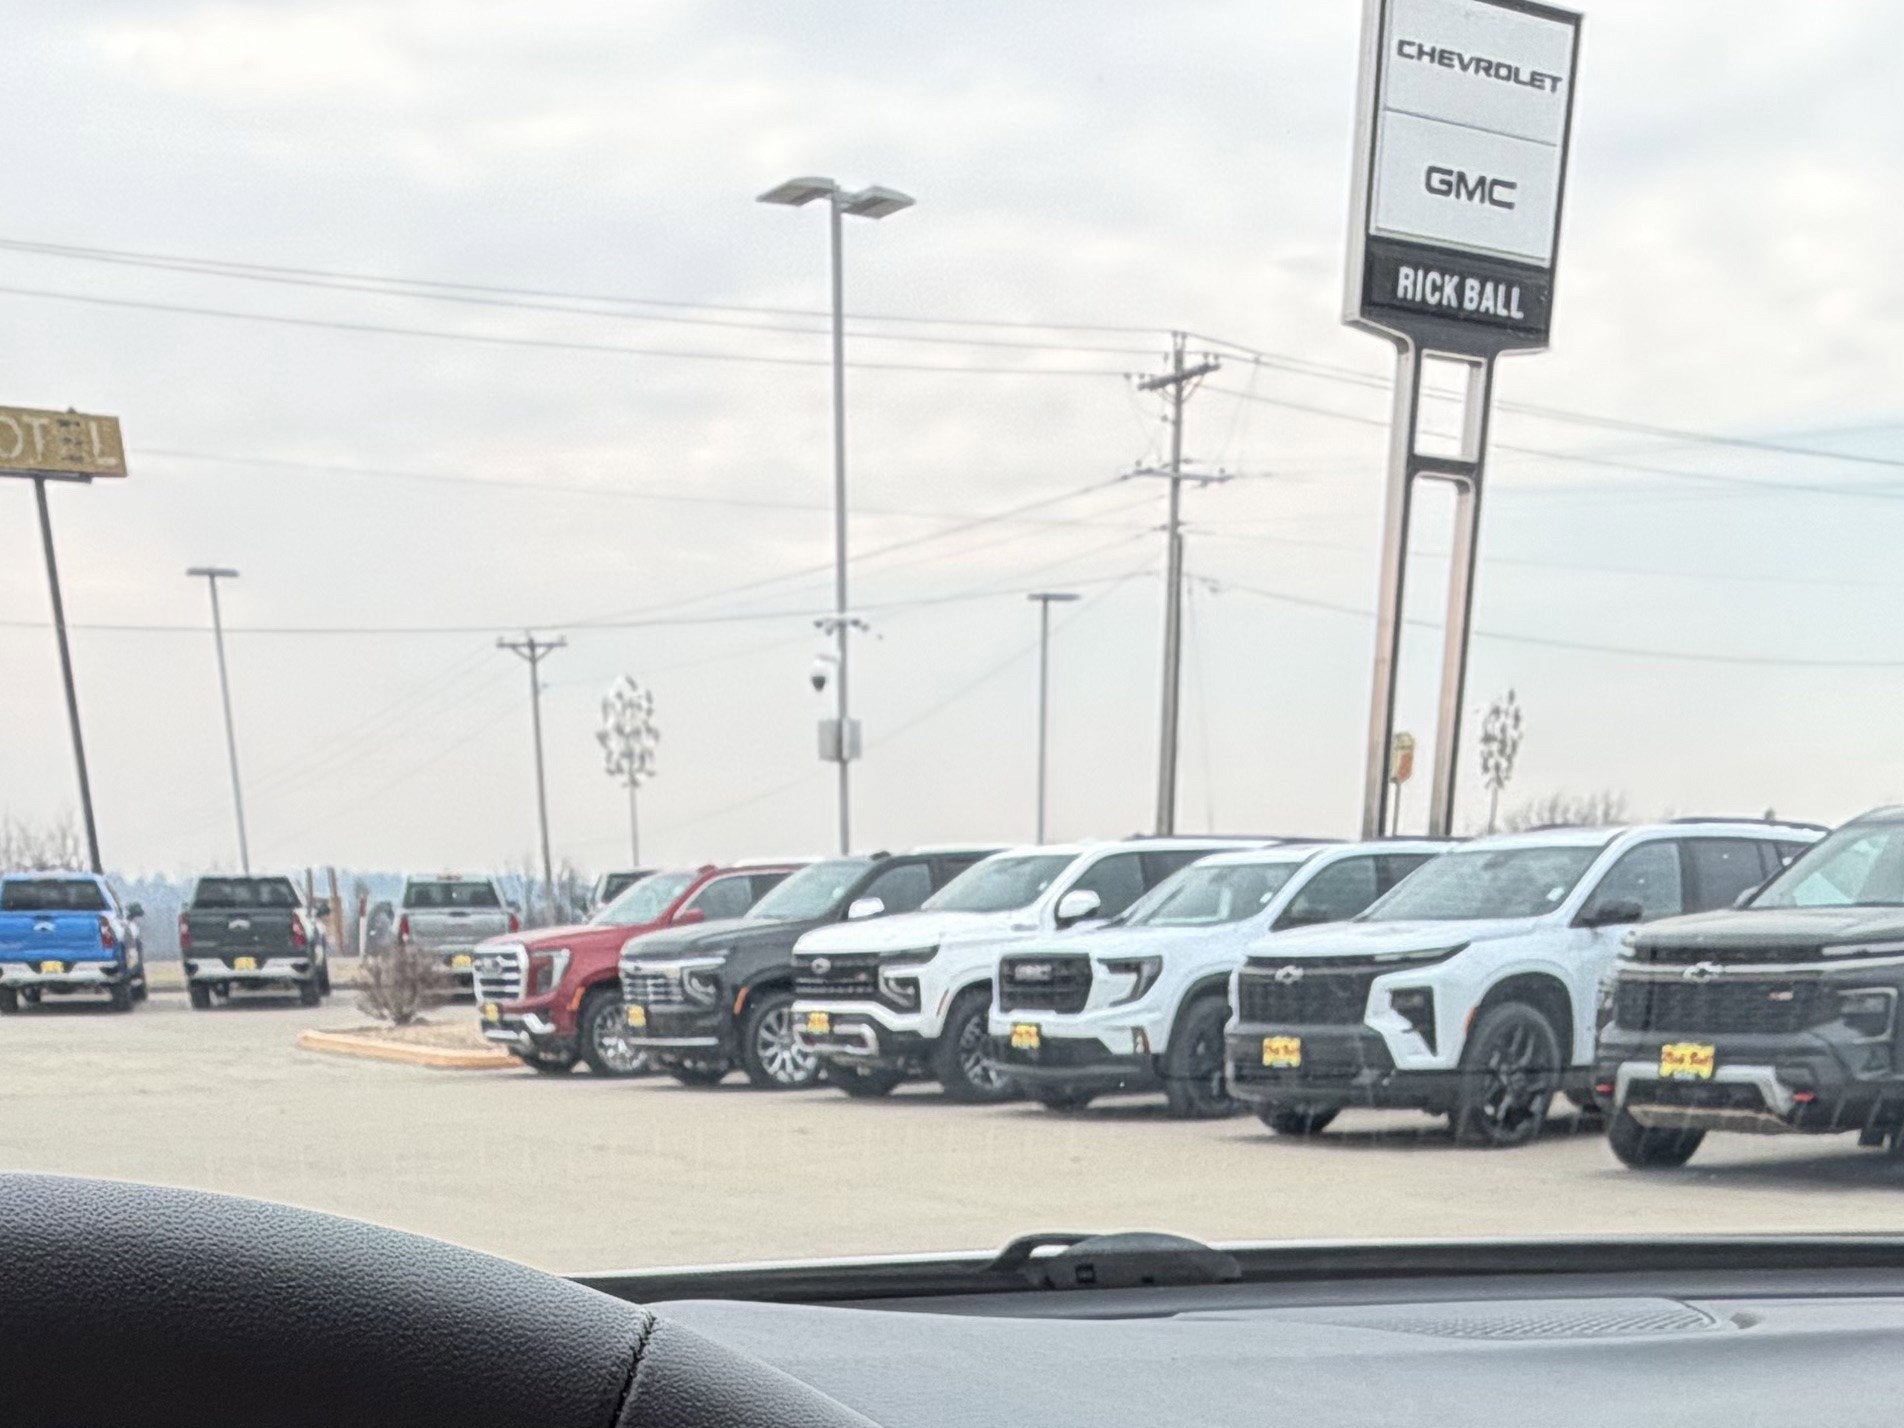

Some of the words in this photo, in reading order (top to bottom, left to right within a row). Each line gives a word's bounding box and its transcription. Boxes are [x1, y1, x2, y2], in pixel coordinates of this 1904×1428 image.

[1397, 38, 1563, 93] CHEVROLET
[1425, 165, 1517, 210] GMC
[1398, 266, 1460, 307] RICK
[1463, 277, 1524, 320] BALL
